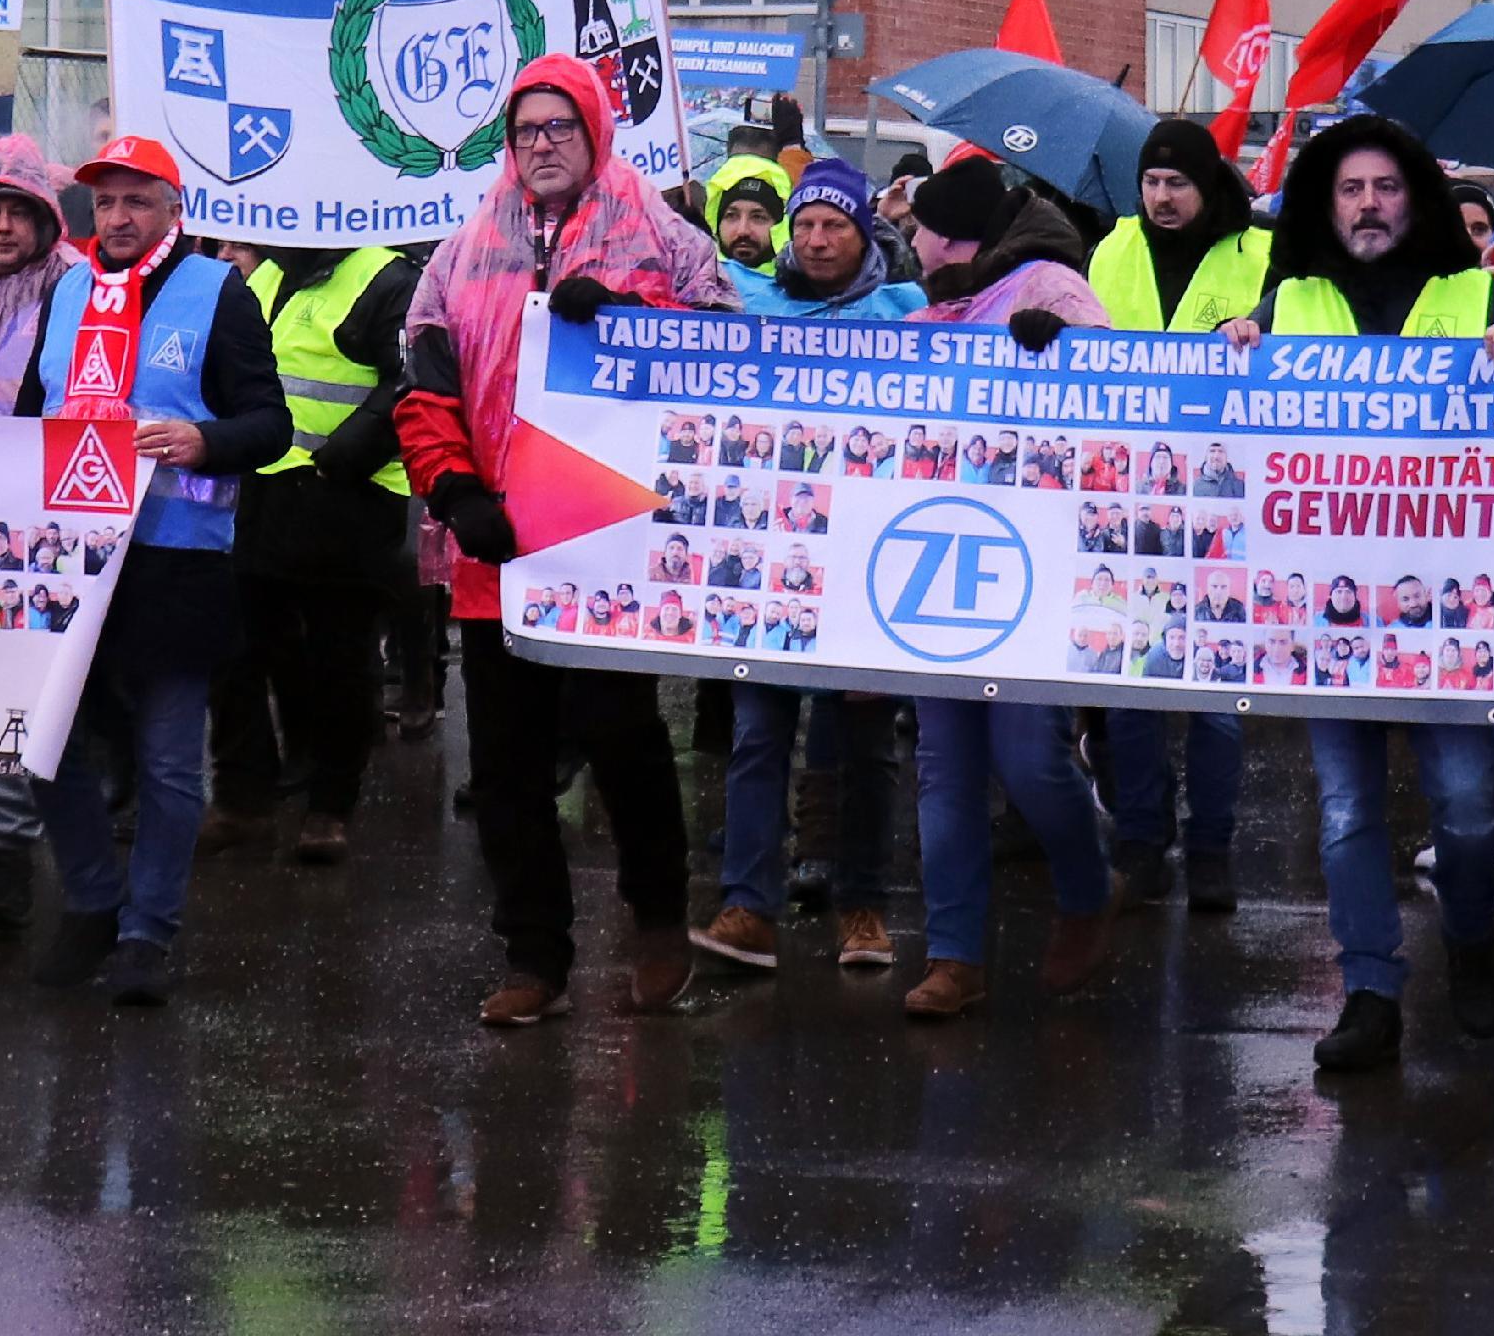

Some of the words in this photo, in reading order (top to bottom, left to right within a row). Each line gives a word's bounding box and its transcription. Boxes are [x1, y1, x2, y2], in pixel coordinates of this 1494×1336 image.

[395, 22, 496, 118] GE
[181, 185, 299, 231] Meine
[315, 192, 466, 234] Heimat,
[595, 314, 751, 353] TAUSEND
[760, 324, 921, 362] FREUNDE
[928, 331, 1061, 371] STEHEN
[1069, 339, 1251, 377] ZUSAMMEN
[1267, 342, 1454, 384] SCHALKE
[591, 354, 637, 393] ZF
[648, 360, 761, 401] MUSS
[771, 366, 955, 413] ZUSAGEN
[966, 378, 1171, 424] EINHALTEN
